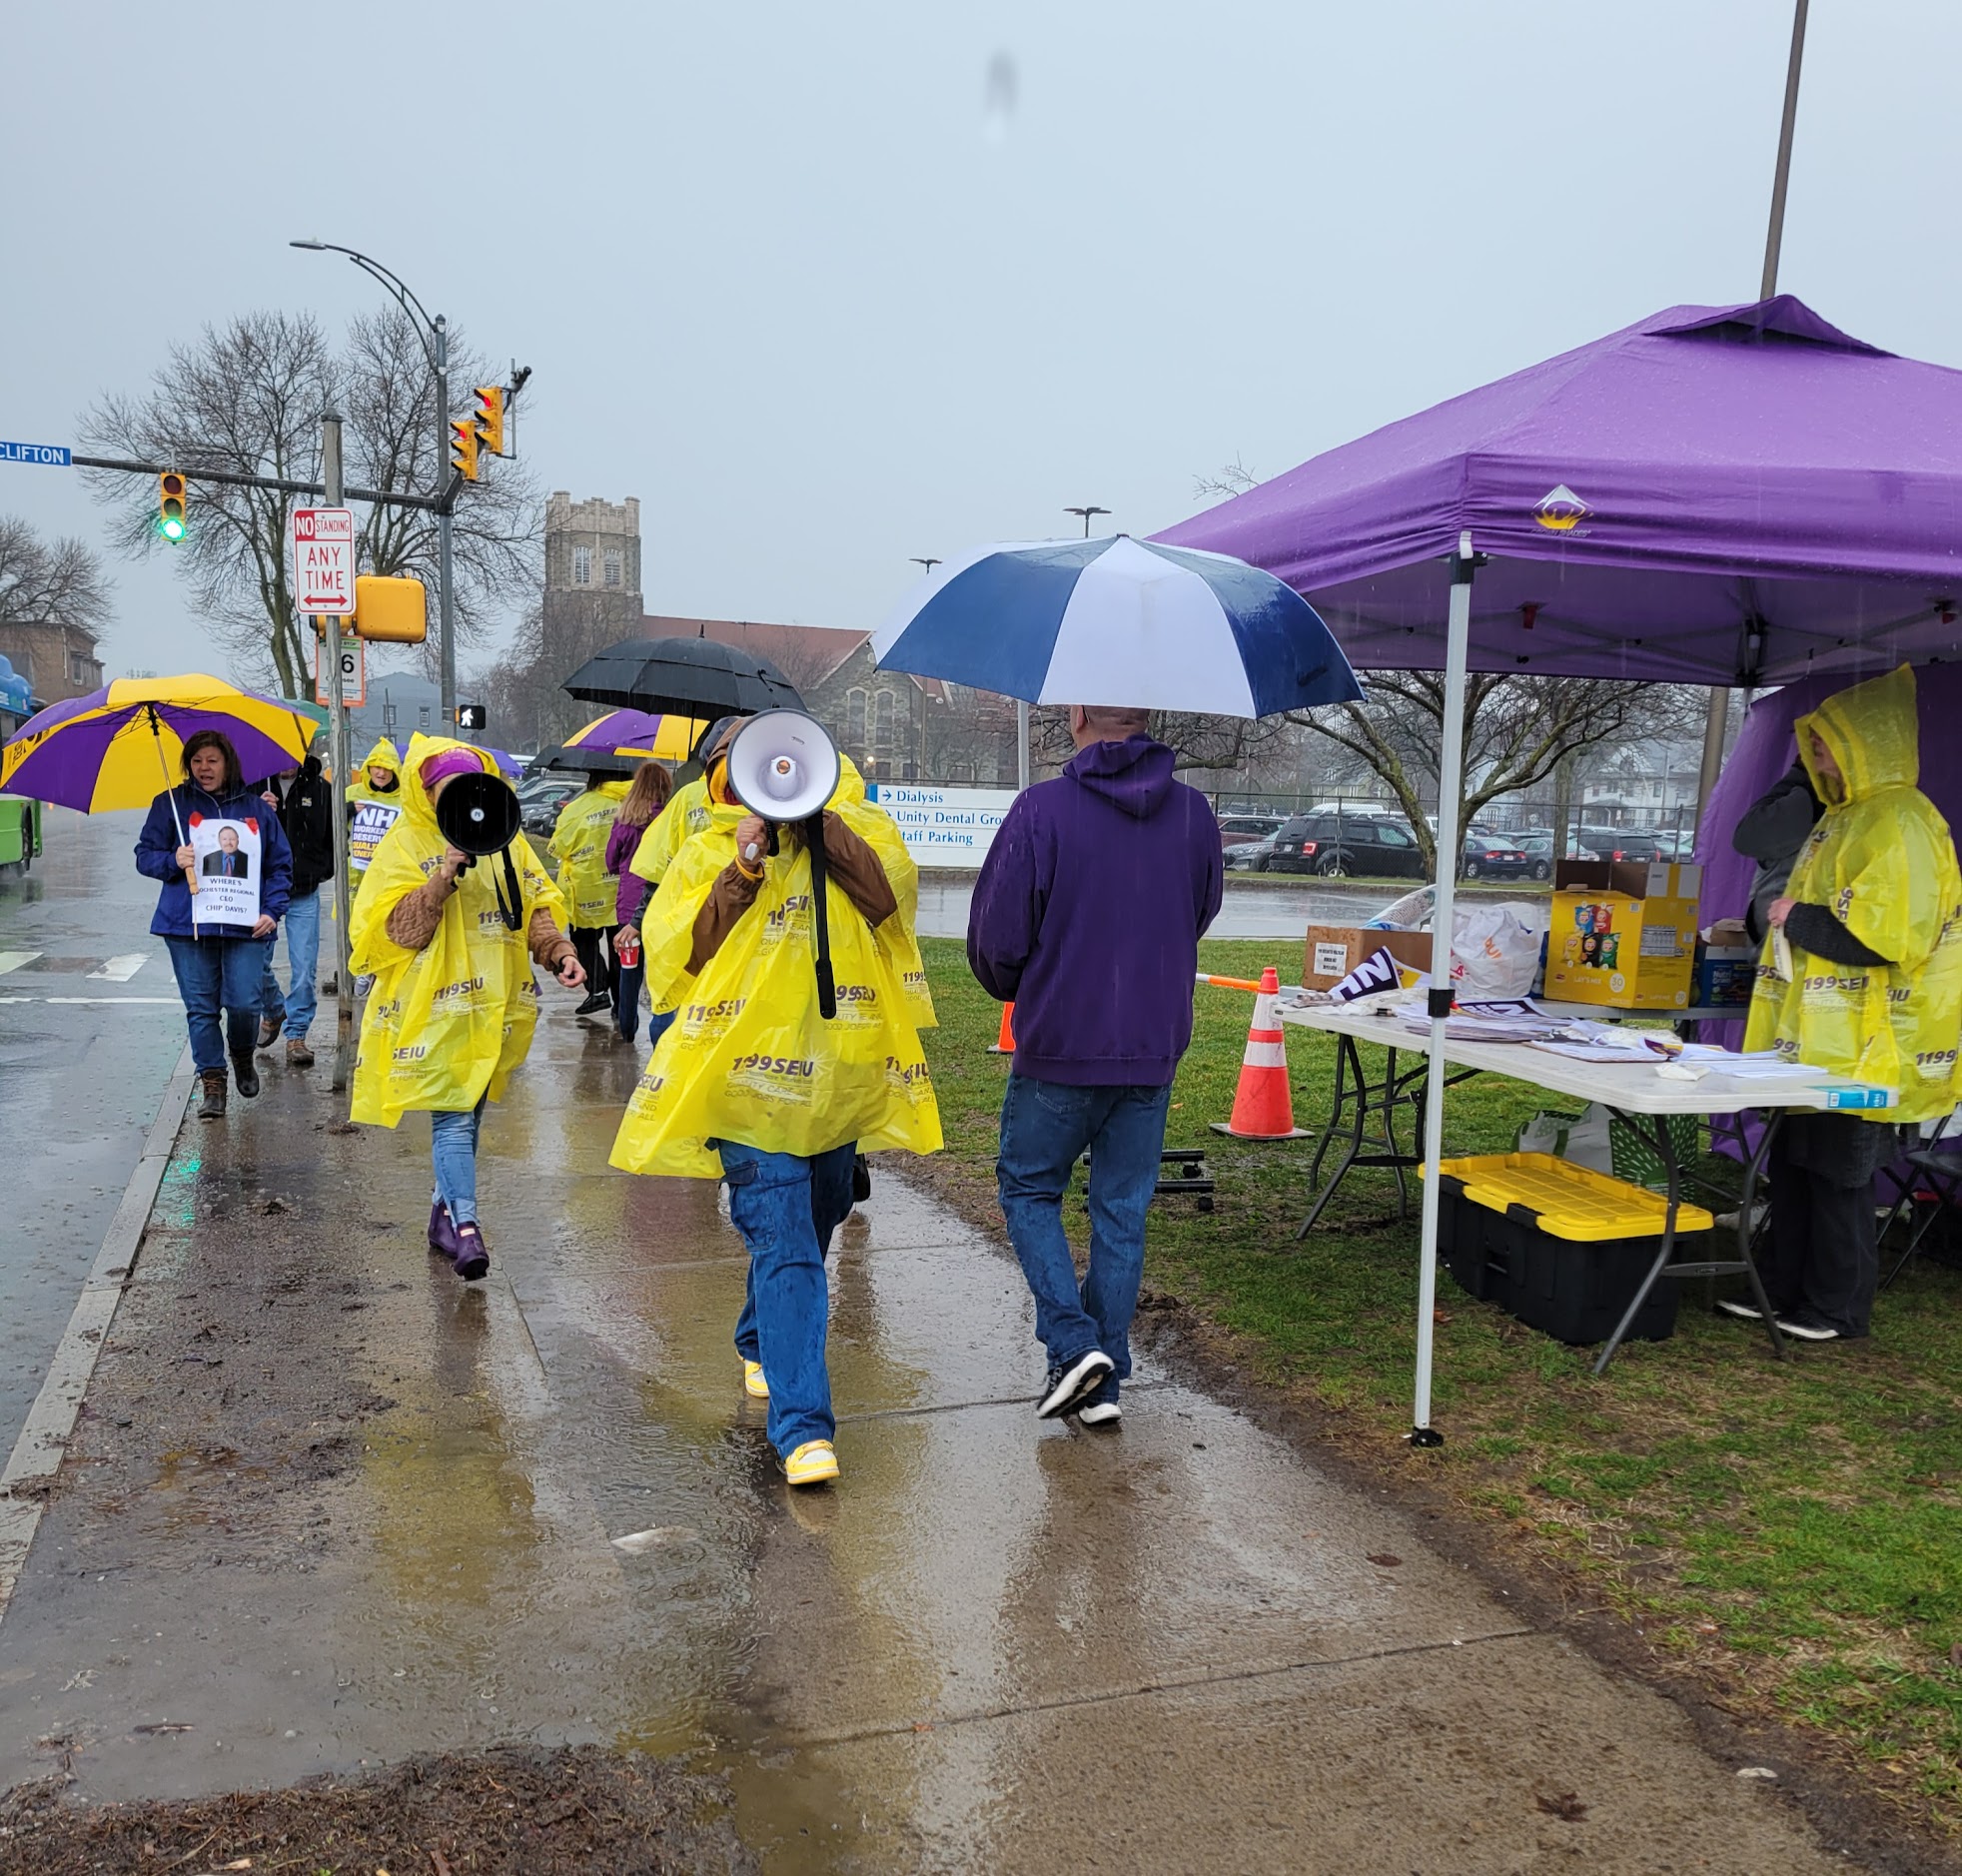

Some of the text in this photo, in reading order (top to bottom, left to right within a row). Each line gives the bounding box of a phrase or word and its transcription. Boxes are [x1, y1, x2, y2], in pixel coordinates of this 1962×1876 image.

[0, 444, 65, 465] CLIFTON
[296, 516, 349, 536] NO STANDING
[307, 546, 341, 566] ANY
[305, 570, 345, 590] TIME
[341, 654, 354, 673] 6
[896, 790, 944, 805] Dialysis
[896, 810, 1004, 825] Unity Dental Gro
[353, 833, 383, 843] DESER
[902, 830, 973, 847] taff Parking
[210, 877, 242, 886] WHERE'S
[225, 905, 248, 914] DAVIS?
